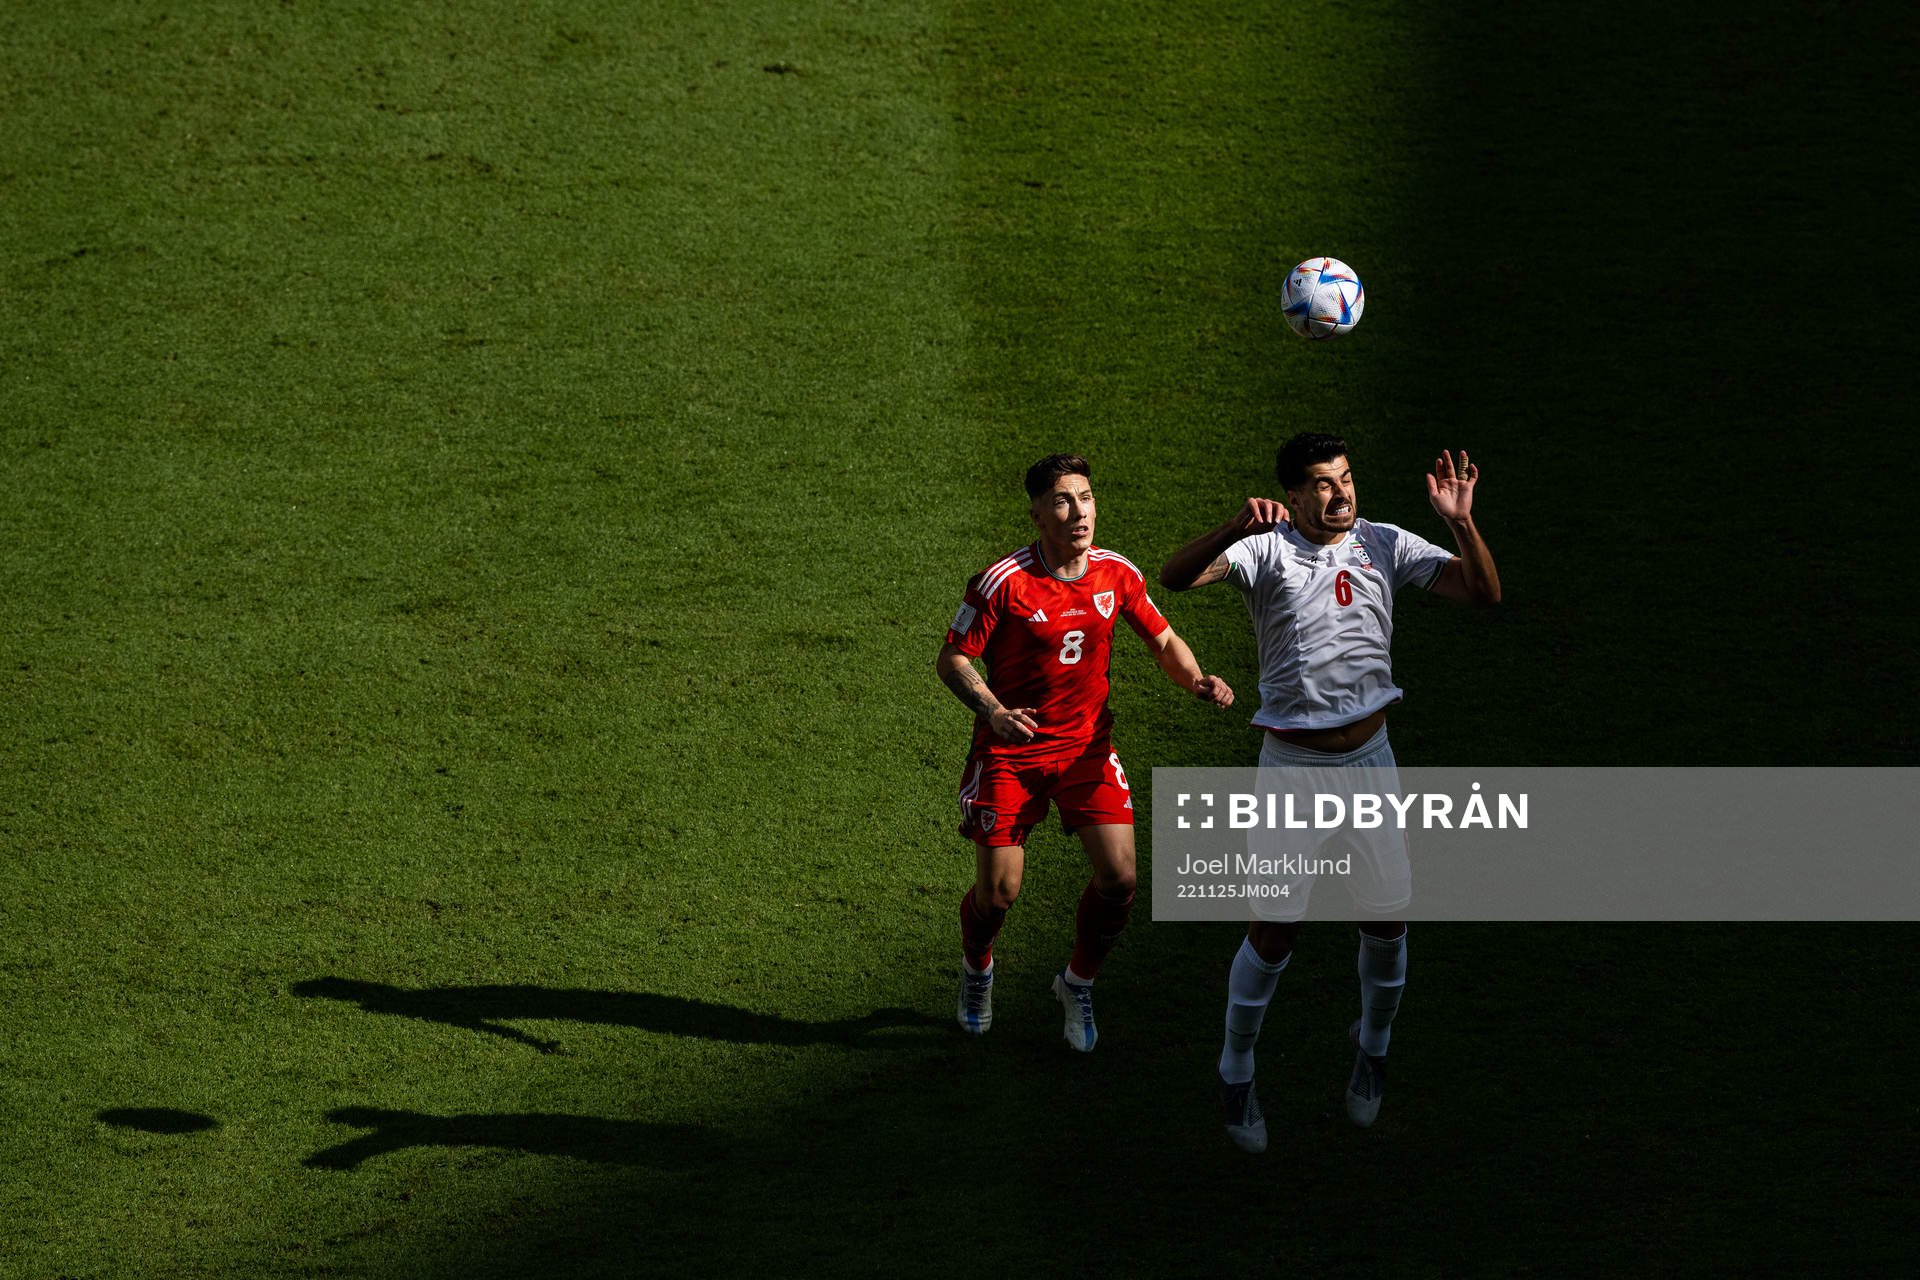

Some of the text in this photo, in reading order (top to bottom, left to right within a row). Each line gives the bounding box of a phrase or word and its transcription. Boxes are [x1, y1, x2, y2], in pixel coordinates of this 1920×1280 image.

[1335, 570, 1353, 607] 6
[1058, 630, 1085, 665] 8
[1108, 752, 1129, 790] 8
